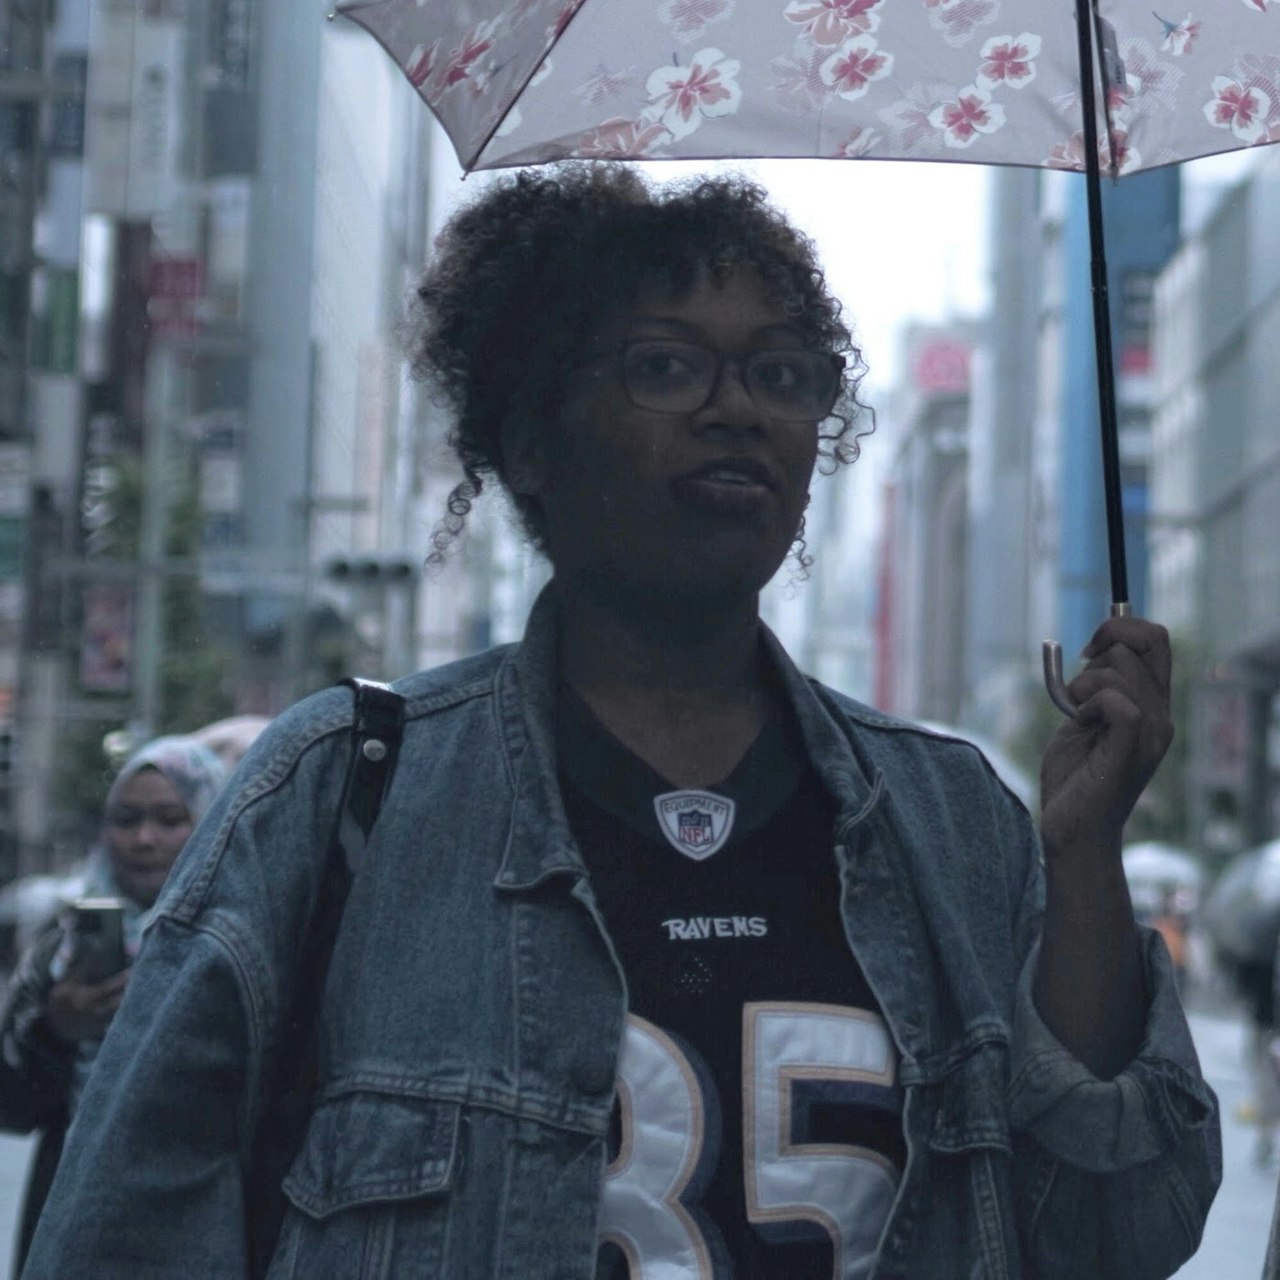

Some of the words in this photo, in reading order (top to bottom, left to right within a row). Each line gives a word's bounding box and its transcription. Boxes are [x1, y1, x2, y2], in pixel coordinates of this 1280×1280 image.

[664, 797, 726, 816] EQUIPMENT
[680, 824, 713, 845] NFL
[661, 916, 768, 939] RAVENS
